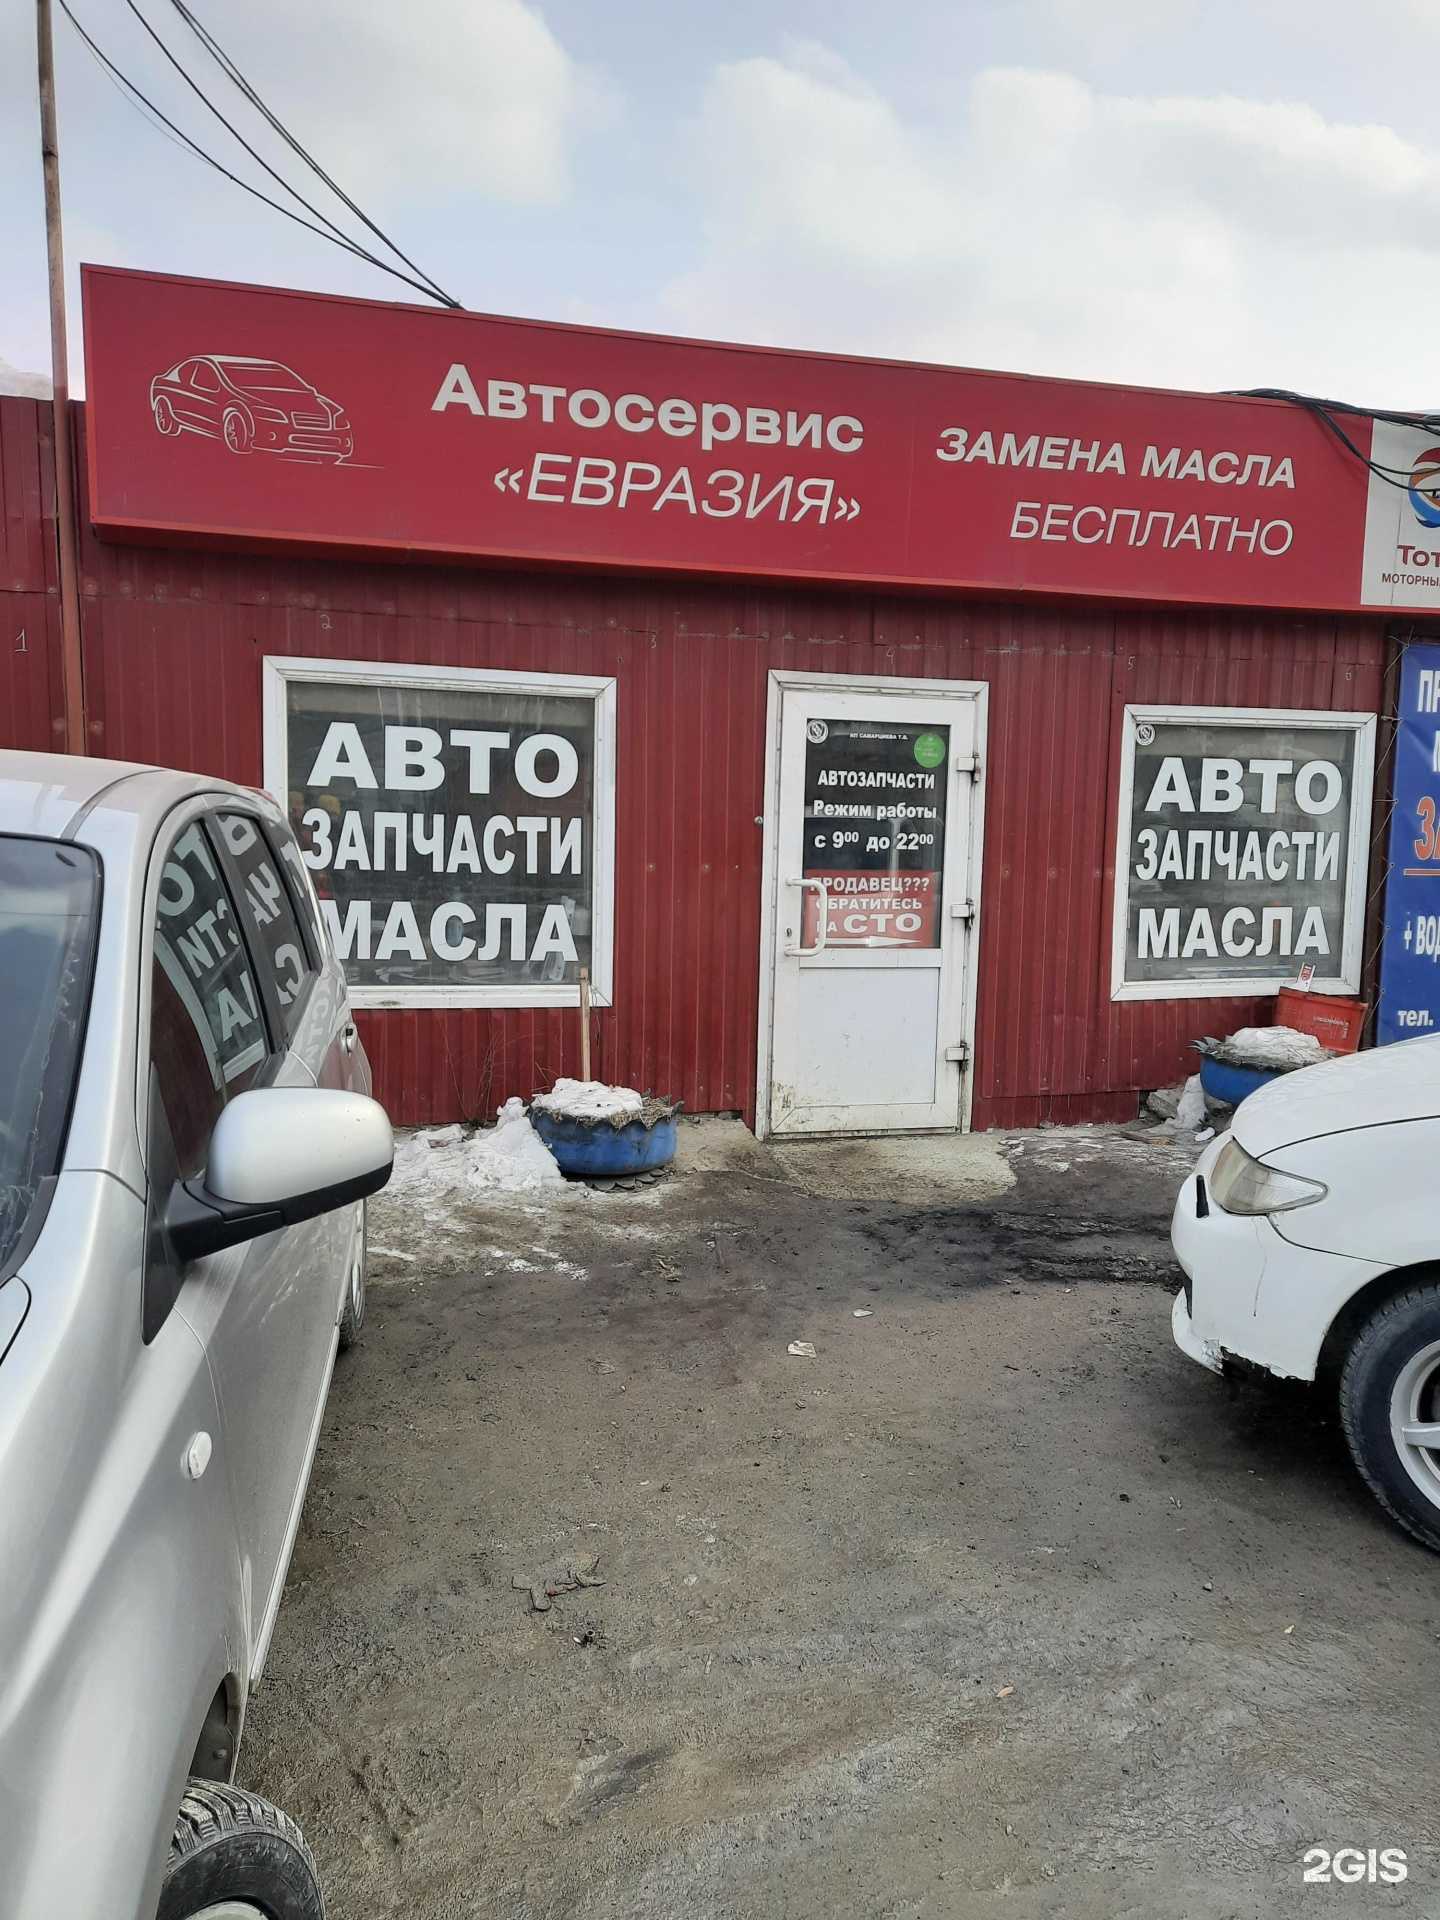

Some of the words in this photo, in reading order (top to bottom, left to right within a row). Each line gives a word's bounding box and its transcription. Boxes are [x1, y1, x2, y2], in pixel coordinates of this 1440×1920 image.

[431, 363, 864, 453] Автосервис
[936, 427, 1127, 475] ЗАМЕНА
[1140, 445, 1296, 489] МАСЛА
[493, 452, 861, 525] «ЕВРАЗИЯ»
[1009, 501, 1294, 557] БЕСПЛАТНО
[1381, 573, 1440, 587] МОТОРНЫ
[15, 628, 29, 653] 1
[306, 721, 579, 798] АВТО
[818, 770, 935, 789] АВТОЗАПЧАСТИ
[1144, 757, 1343, 815] АВТО
[814, 800, 872, 817] Режим
[876, 802, 936, 820] работы
[301, 808, 582, 875] ЗАПЧАСТИ
[866, 835, 890, 852] до
[1135, 828, 1340, 881] ЗАПЧАСТИ
[318, 899, 578, 962] МАСЛА
[843, 912, 922, 934] СТО
[1137, 906, 1330, 959] МАСЛА
[1397, 1009, 1434, 1027] тел.
